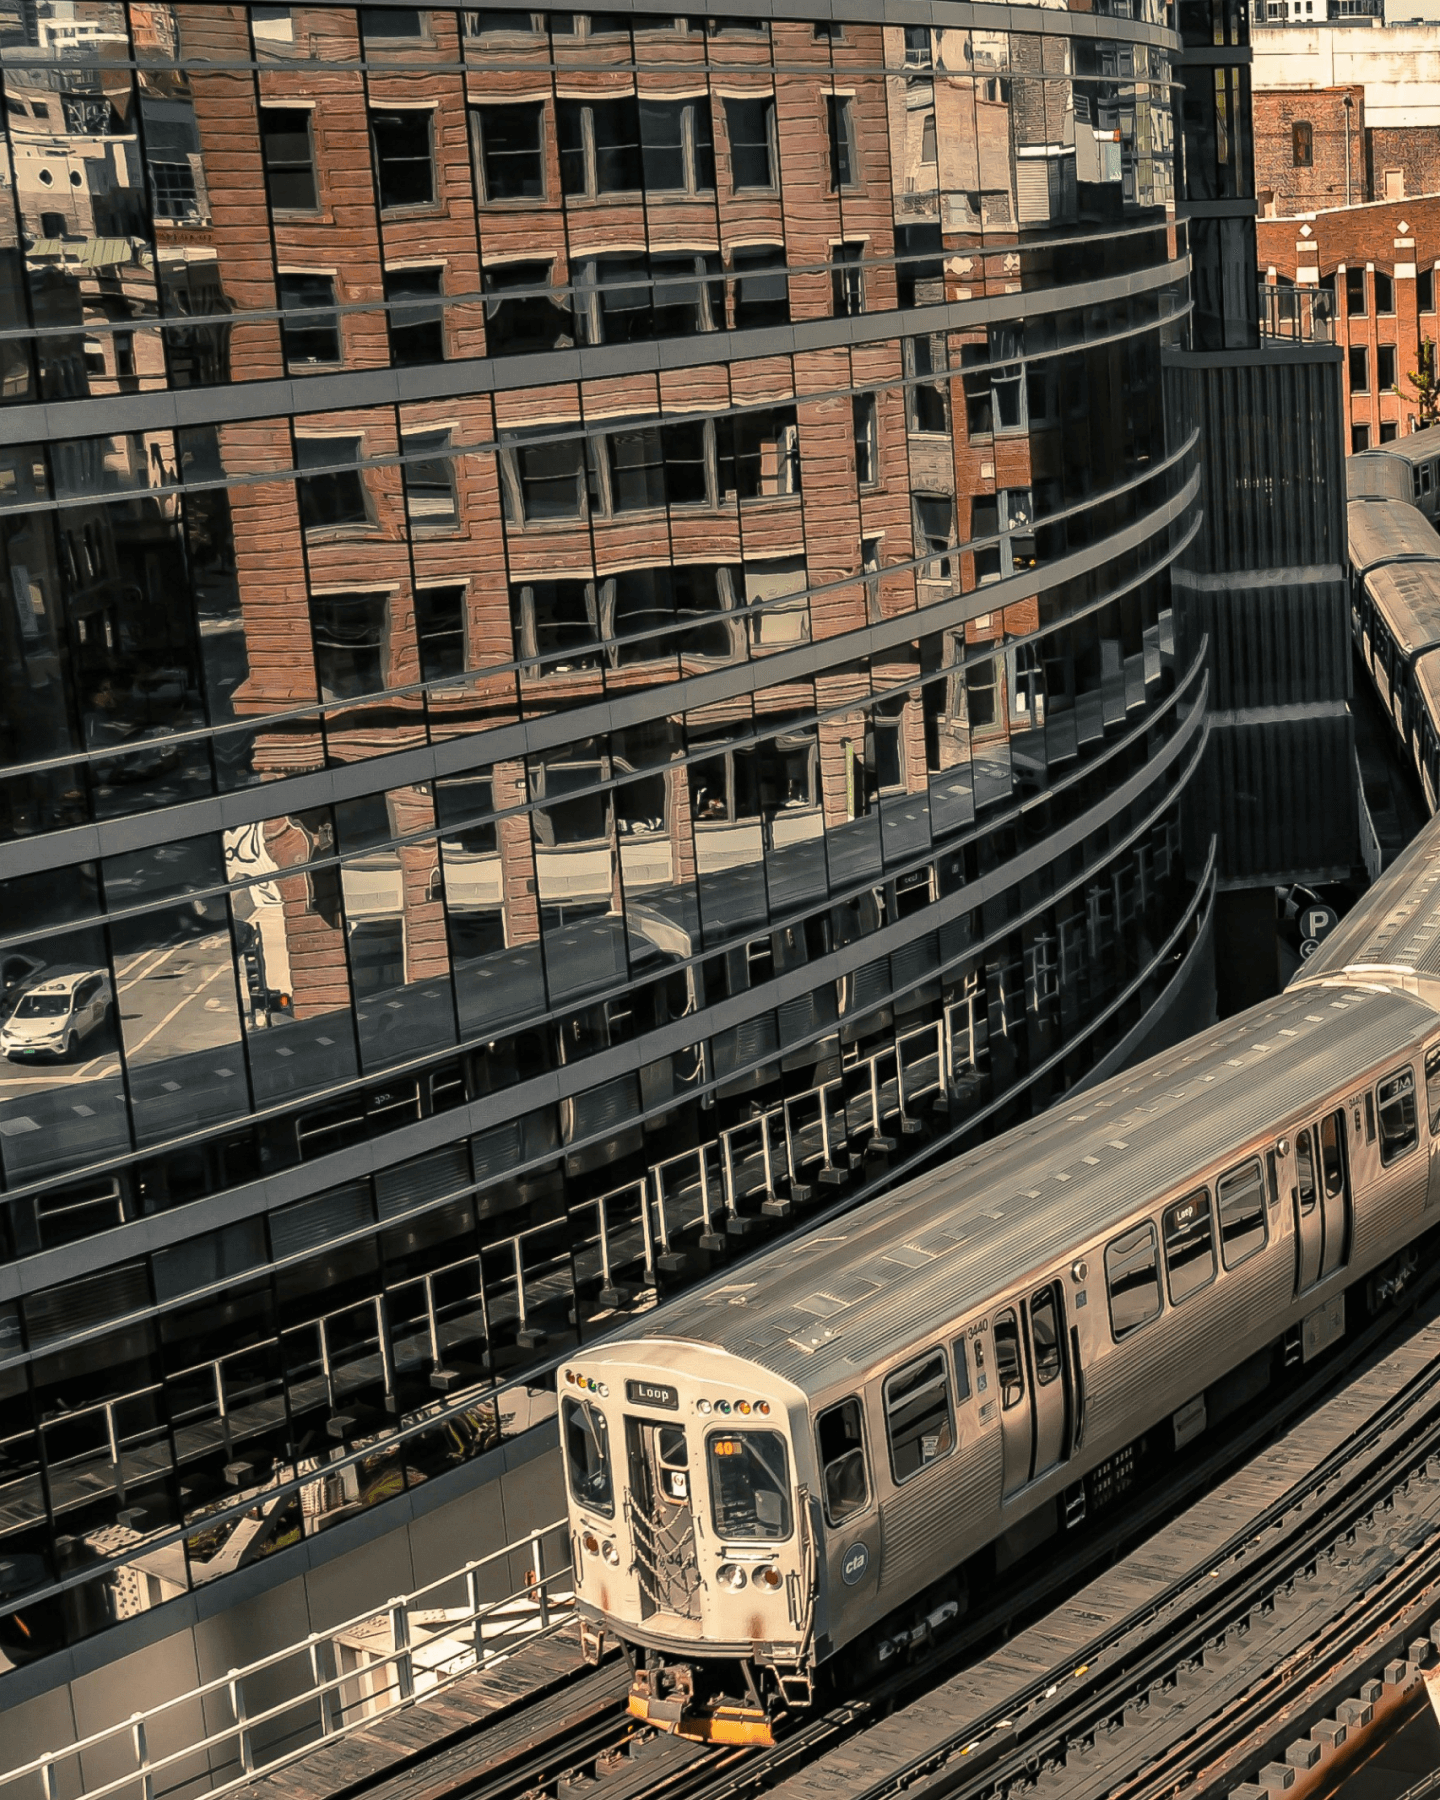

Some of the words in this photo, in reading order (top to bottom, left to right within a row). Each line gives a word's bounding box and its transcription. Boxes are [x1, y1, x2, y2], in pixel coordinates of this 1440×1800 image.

[1309, 911, 1329, 938] P
[1176, 1205, 1193, 1222] Loop
[967, 1318, 988, 1341] 3440
[638, 1384, 669, 1402] Loop
[845, 1552, 865, 1574] cta
